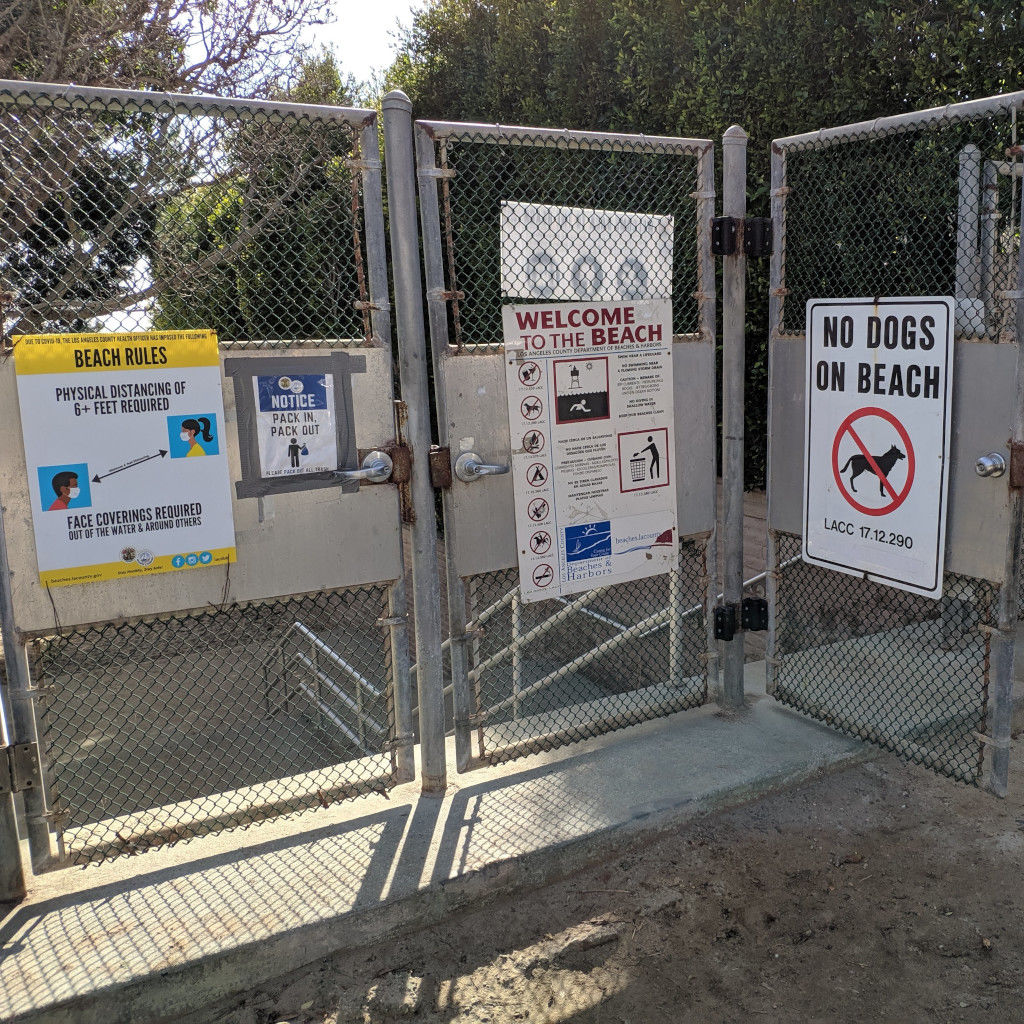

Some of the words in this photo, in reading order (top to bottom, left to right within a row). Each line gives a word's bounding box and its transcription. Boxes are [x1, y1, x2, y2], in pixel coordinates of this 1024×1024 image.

[515, 307, 635, 330] WELCOME
[520, 334, 546, 350] TO
[549, 332, 585, 348] THE
[591, 324, 662, 346] BEACH
[823, 315, 854, 348] NO
[866, 315, 935, 350] DOGS
[74, 348, 121, 368] BEACH
[125, 346, 168, 366] RULES
[816, 360, 846, 392] ON
[857, 362, 940, 399] BEACH
[55, 385, 108, 402] PHYSICAL
[110, 381, 172, 399] DISTANCING
[174, 381, 186, 395] OF
[271, 394, 316, 409] NOTICE
[74, 402, 90, 416] 6+
[94, 400, 117, 415] FEET
[121, 397, 170, 413] REQUIRED
[272, 412, 300, 424] PACK
[304, 411, 317, 423] IN,
[271, 425, 298, 436] PACK
[302, 424, 320, 436] OUT
[67, 514, 93, 529] FACE
[96, 508, 153, 527] COVERINGS
[155, 502, 202, 520] REQUIRED
[68, 529, 83, 541] OUT
[85, 528, 94, 539] OF
[96, 526, 110, 538] THE
[111, 523, 136, 536] WATER
[138, 523, 144, 533] &
[145, 519, 174, 532] AROUND
[175, 516, 202, 528] OTHERS
[824, 517, 854, 536] LACC
[859, 526, 913, 549] 17.12.290
[567, 563, 603, 574] Beaches
[567, 569, 612, 581] Harbors
